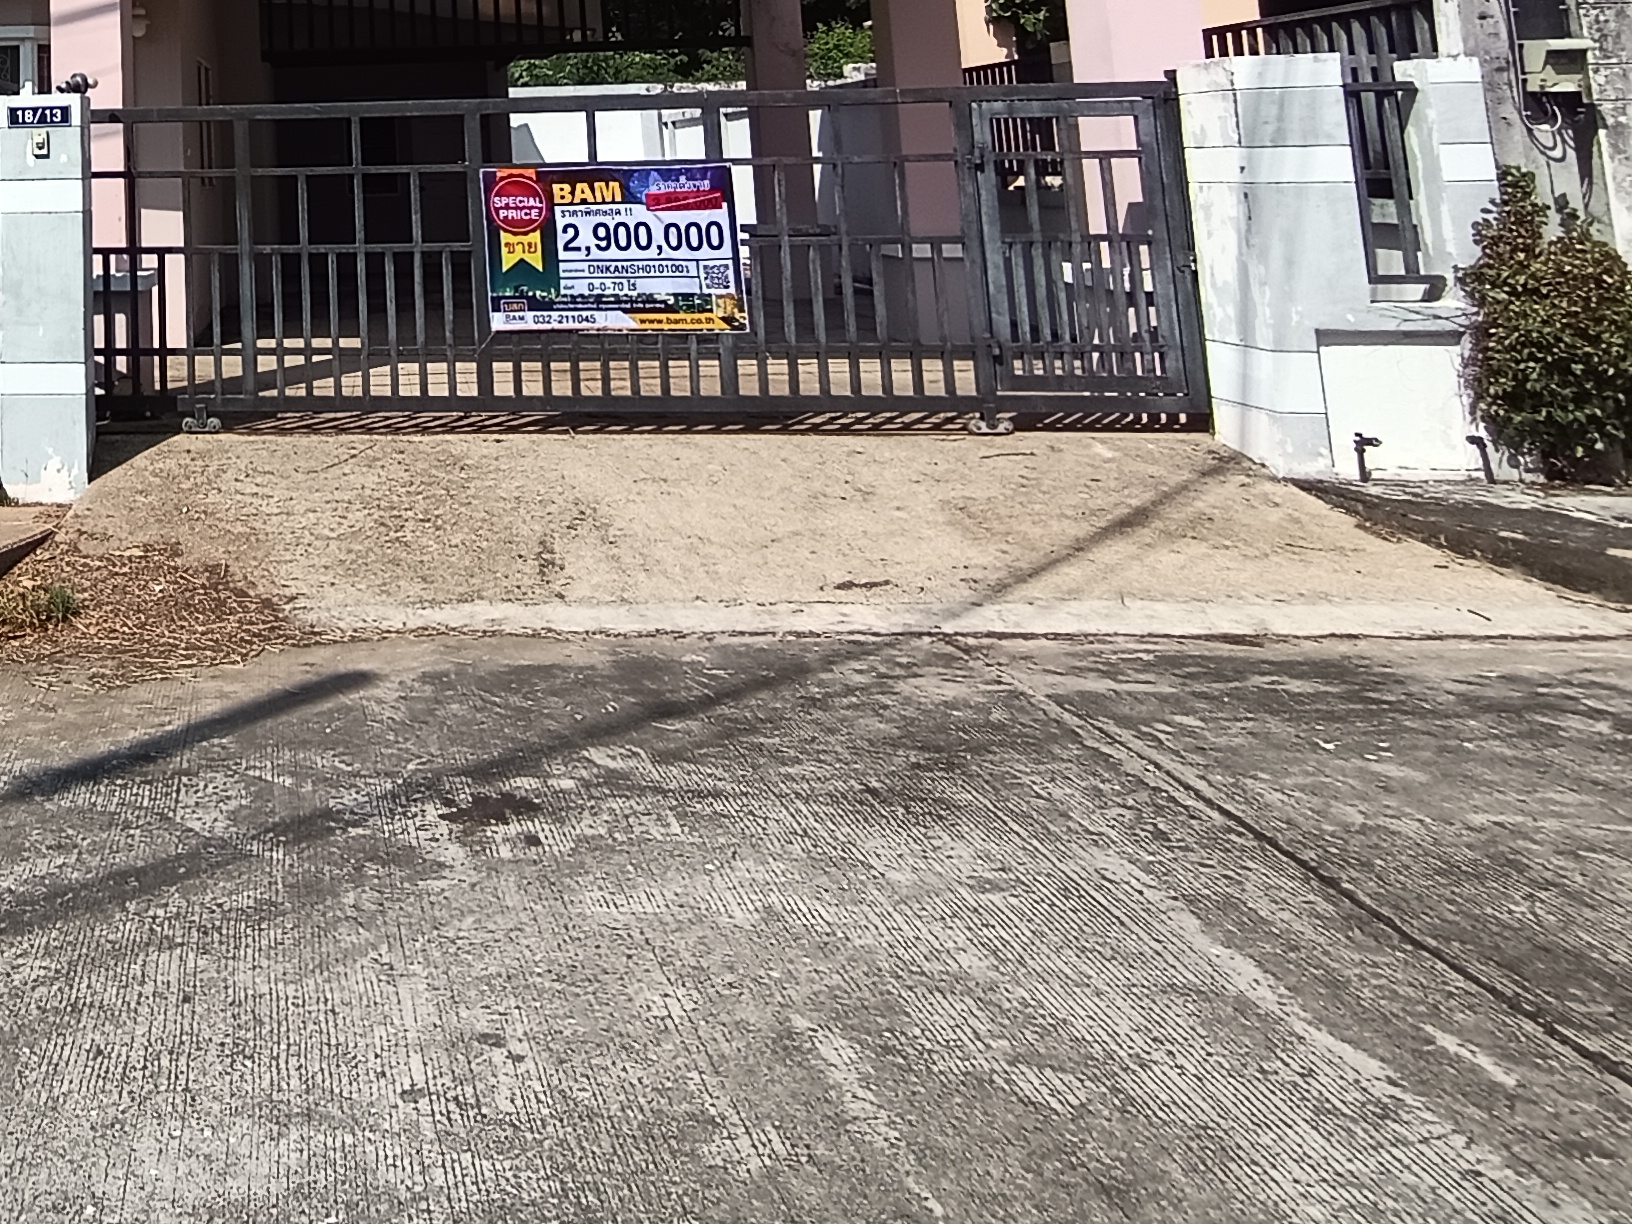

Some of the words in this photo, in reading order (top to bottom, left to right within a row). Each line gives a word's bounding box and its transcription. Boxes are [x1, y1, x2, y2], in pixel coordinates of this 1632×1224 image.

[552, 181, 622, 204] BAM
[493, 196, 543, 208] SPECIAL
[499, 209, 539, 220] PRICE
[561, 220, 724, 256] 2,900,000
[504, 240, 538, 255] ขาย
[505, 314, 525, 324] BAM
[533, 314, 596, 325] 032-211045
[638, 316, 715, 326] www.bam.co.th
